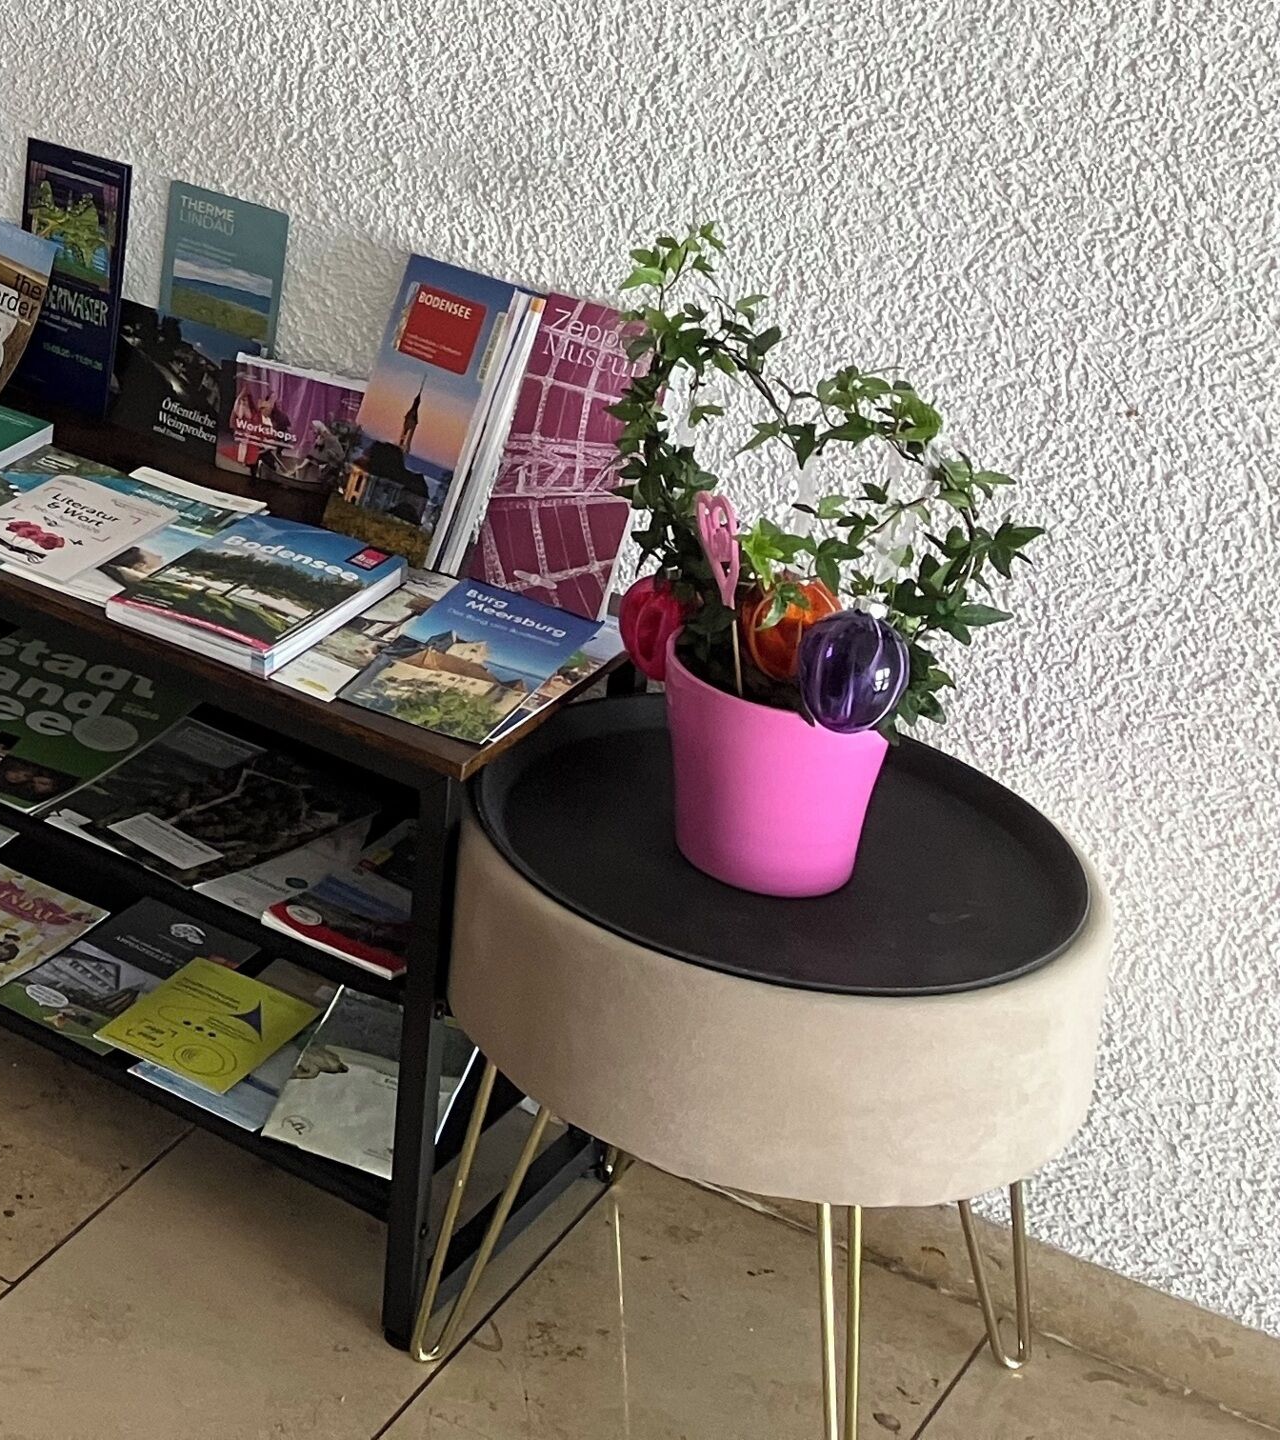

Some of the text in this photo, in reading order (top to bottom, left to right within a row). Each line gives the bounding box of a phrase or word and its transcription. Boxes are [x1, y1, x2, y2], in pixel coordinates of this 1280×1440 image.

[180, 195, 234, 222] THERME
[179, 212, 234, 236] LINDAU
[15, 273, 42, 301] the
[417, 291, 472, 320] BODENSEE
[549, 308, 625, 350] Zepp
[159, 410, 217, 443] Weinproben
[162, 396, 217, 428] Öffentliche
[236, 418, 297, 443] Workshops
[47, 501, 61, 509] &
[63, 507, 104, 527] Wort
[51, 493, 121, 522] Literatur
[222, 534, 359, 584] Bodensee
[465, 588, 509, 610] Burg
[465, 600, 567, 639] Meersburg
